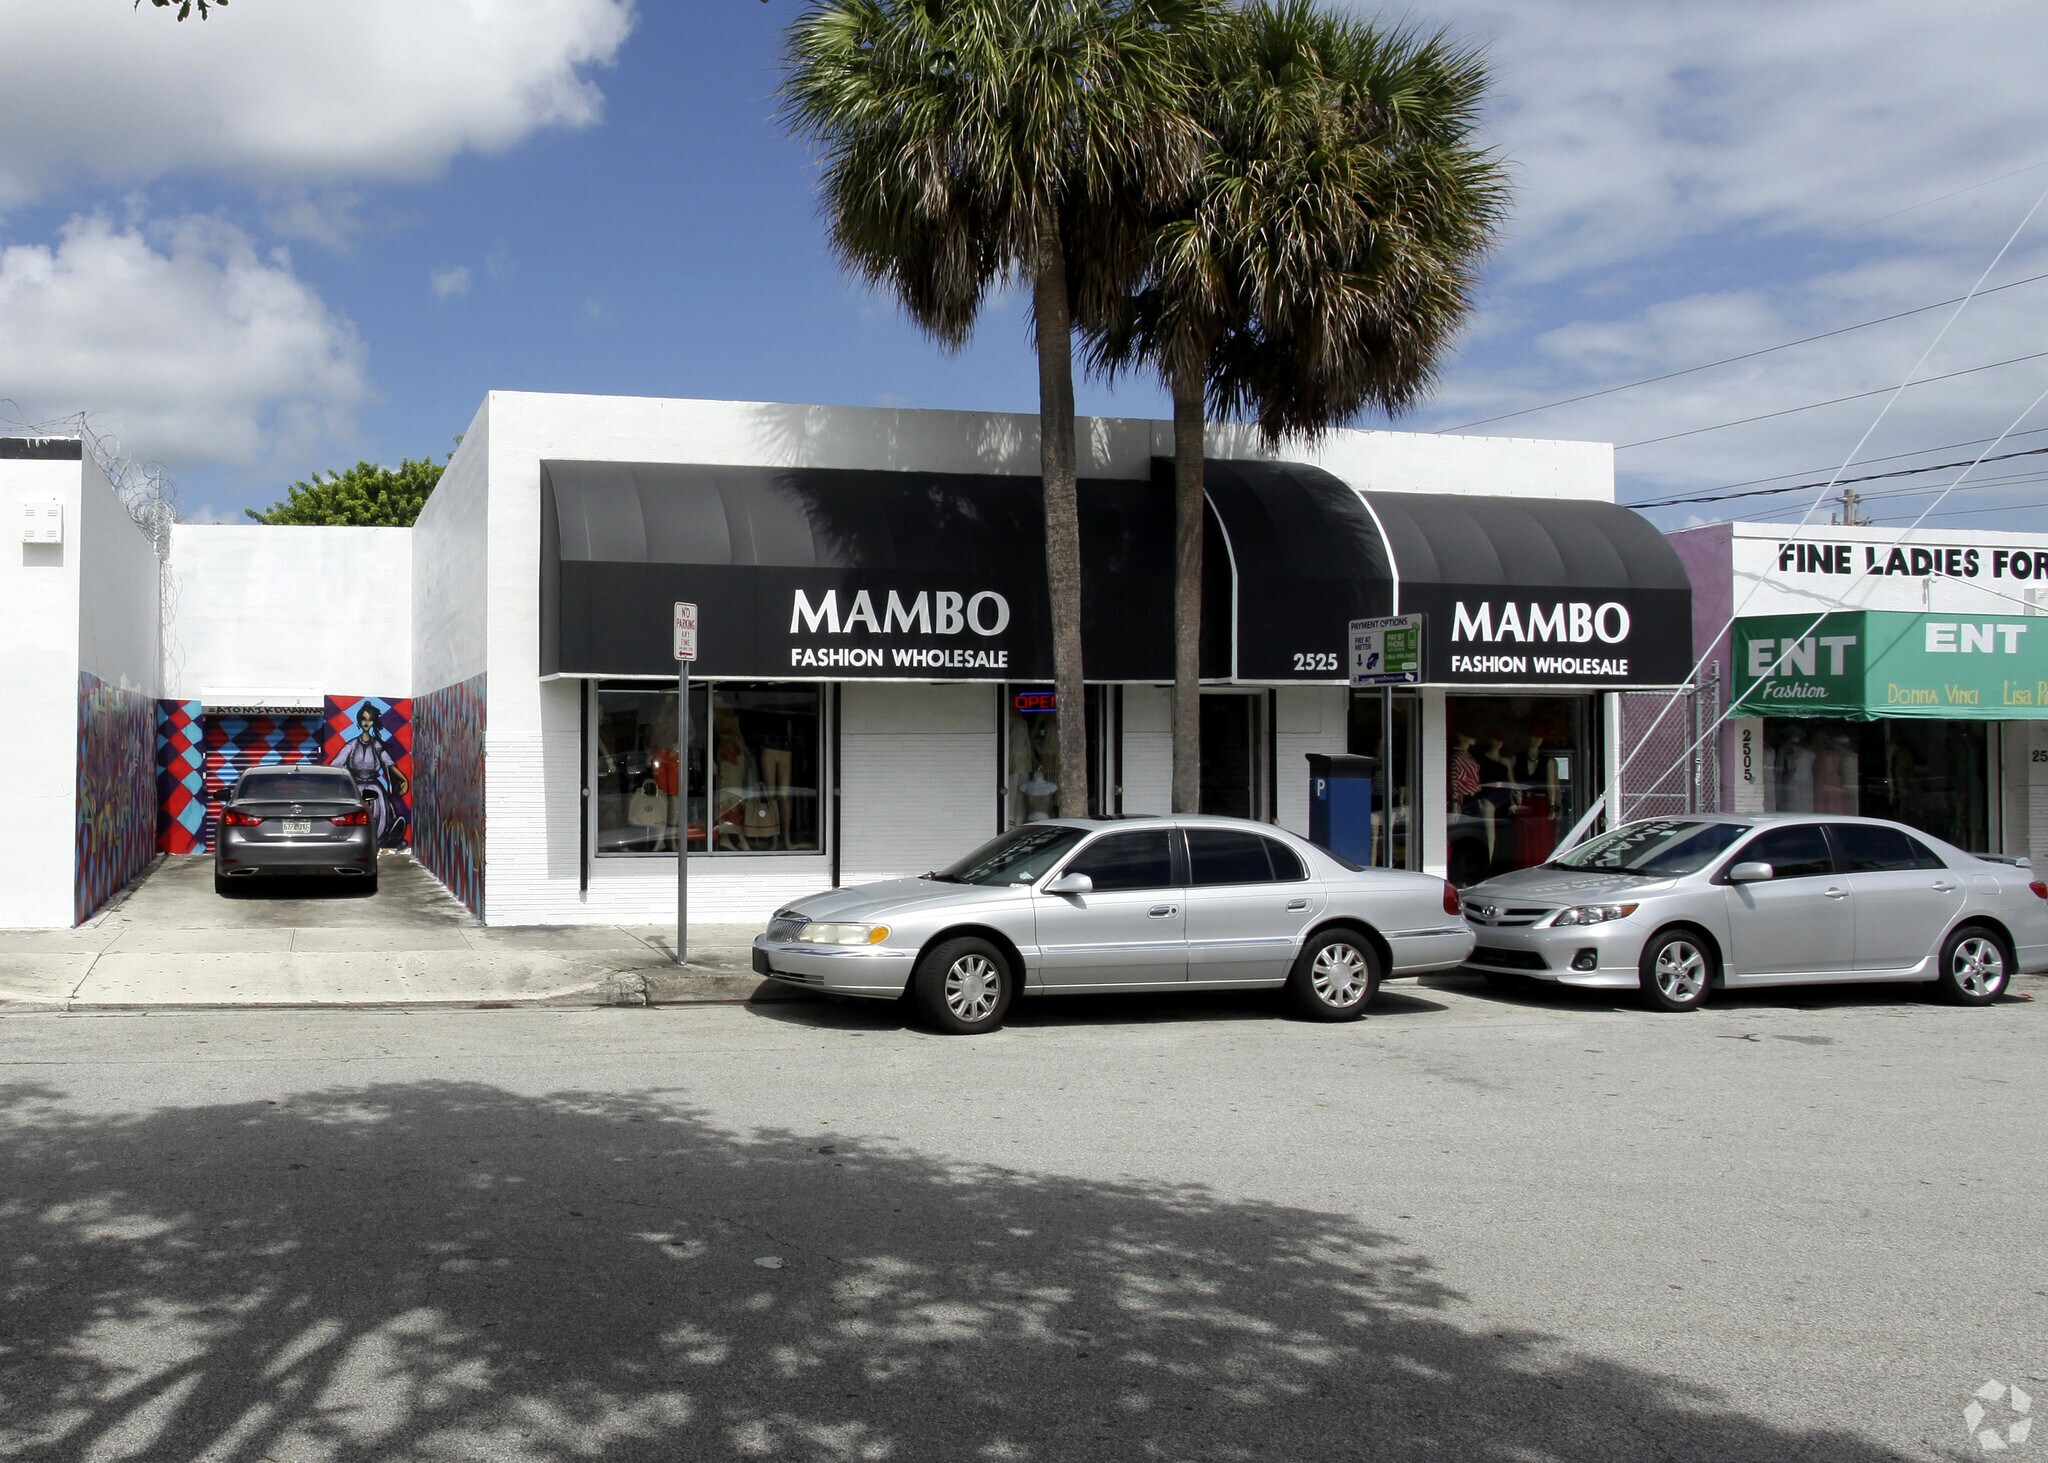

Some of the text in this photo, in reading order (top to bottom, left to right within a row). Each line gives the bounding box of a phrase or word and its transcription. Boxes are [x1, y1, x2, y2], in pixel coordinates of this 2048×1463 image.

[1778, 543, 1852, 574] FINE
[1865, 546, 1979, 577] LADIES
[682, 607, 690, 618] NO
[789, 589, 1010, 637] MAMBO
[1451, 602, 1631, 644] MAMBO
[676, 618, 696, 630] PARKING
[1351, 618, 1408, 630] PAYMENT OPTIONS
[1925, 622, 2027, 654] ENT
[791, 648, 1008, 668] FASHION WHOLESALE
[1293, 653, 1338, 671] 2525
[1451, 655, 1628, 676] FASHION WHOLESALE
[1748, 635, 1856, 677] ENT
[1762, 679, 1829, 700] Fashion
[2003, 680, 2033, 706] Lisa
[1742, 728, 1753, 781] 2505
[1317, 779, 1326, 797] P
